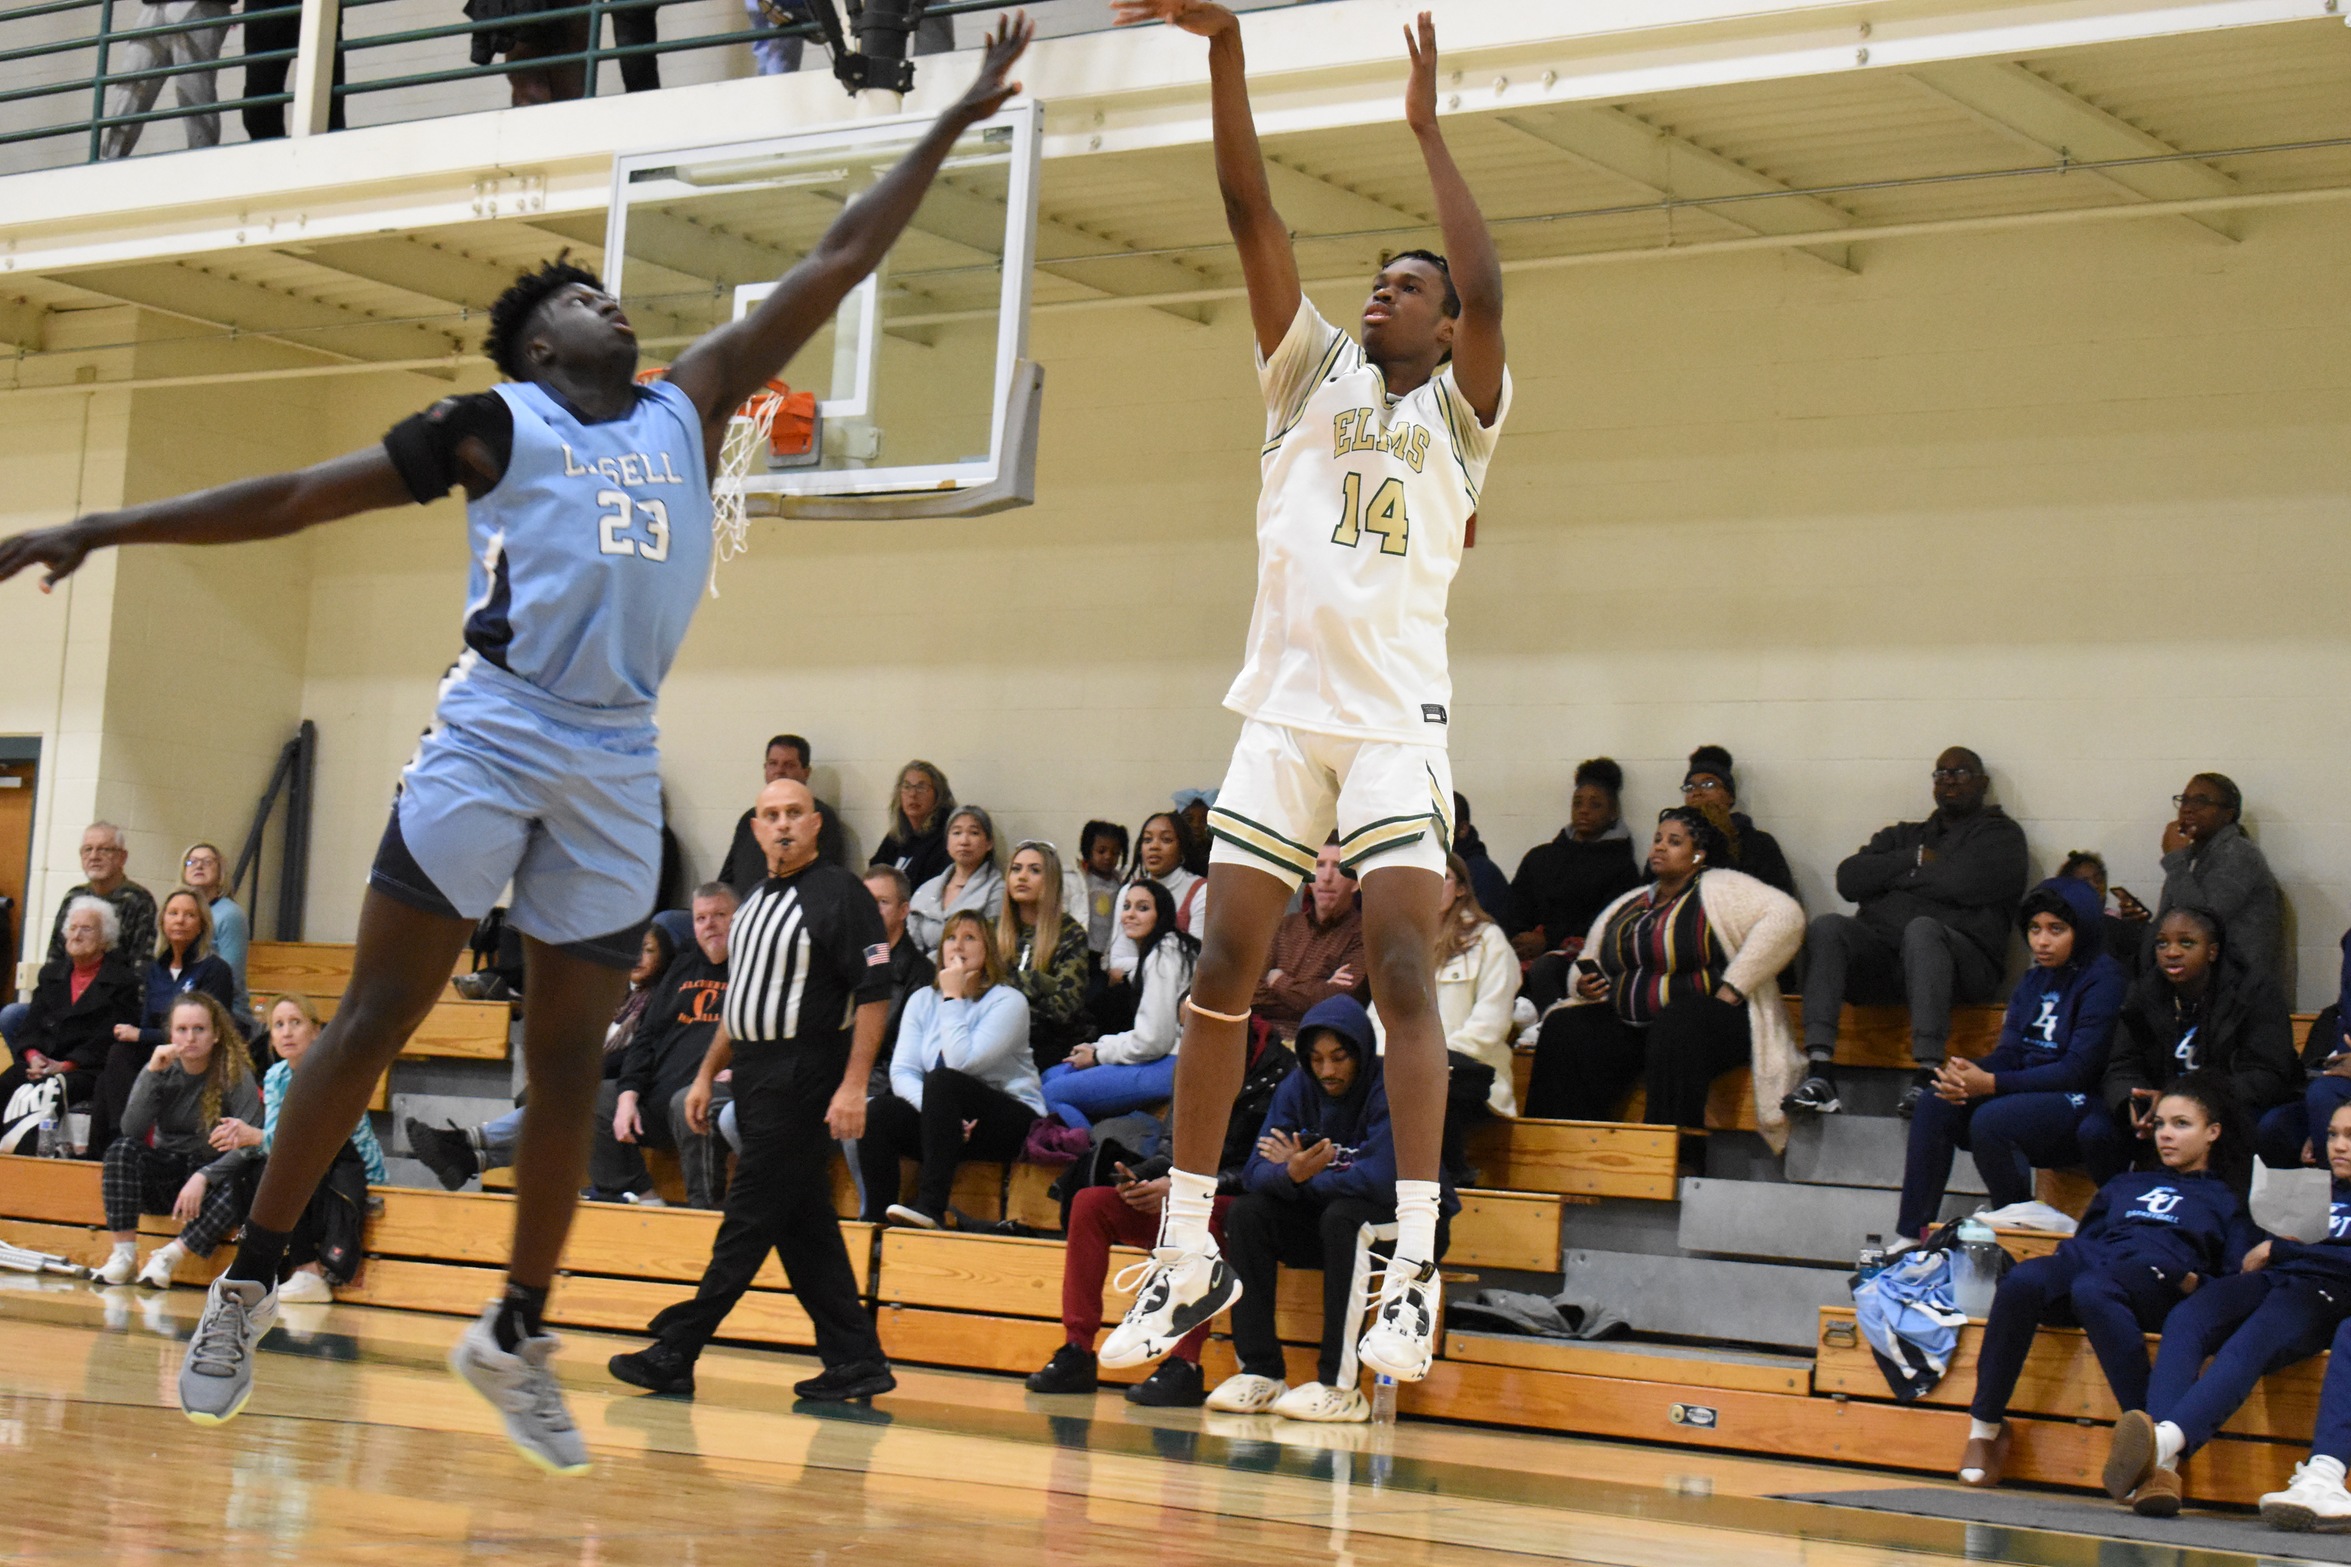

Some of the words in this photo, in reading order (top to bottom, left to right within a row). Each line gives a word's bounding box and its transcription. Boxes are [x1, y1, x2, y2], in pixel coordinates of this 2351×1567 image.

[561, 443, 684, 487] LSELL
[1333, 407, 1431, 473] ELMS
[597, 488, 672, 564] 23
[1331, 471, 1410, 557] 14
